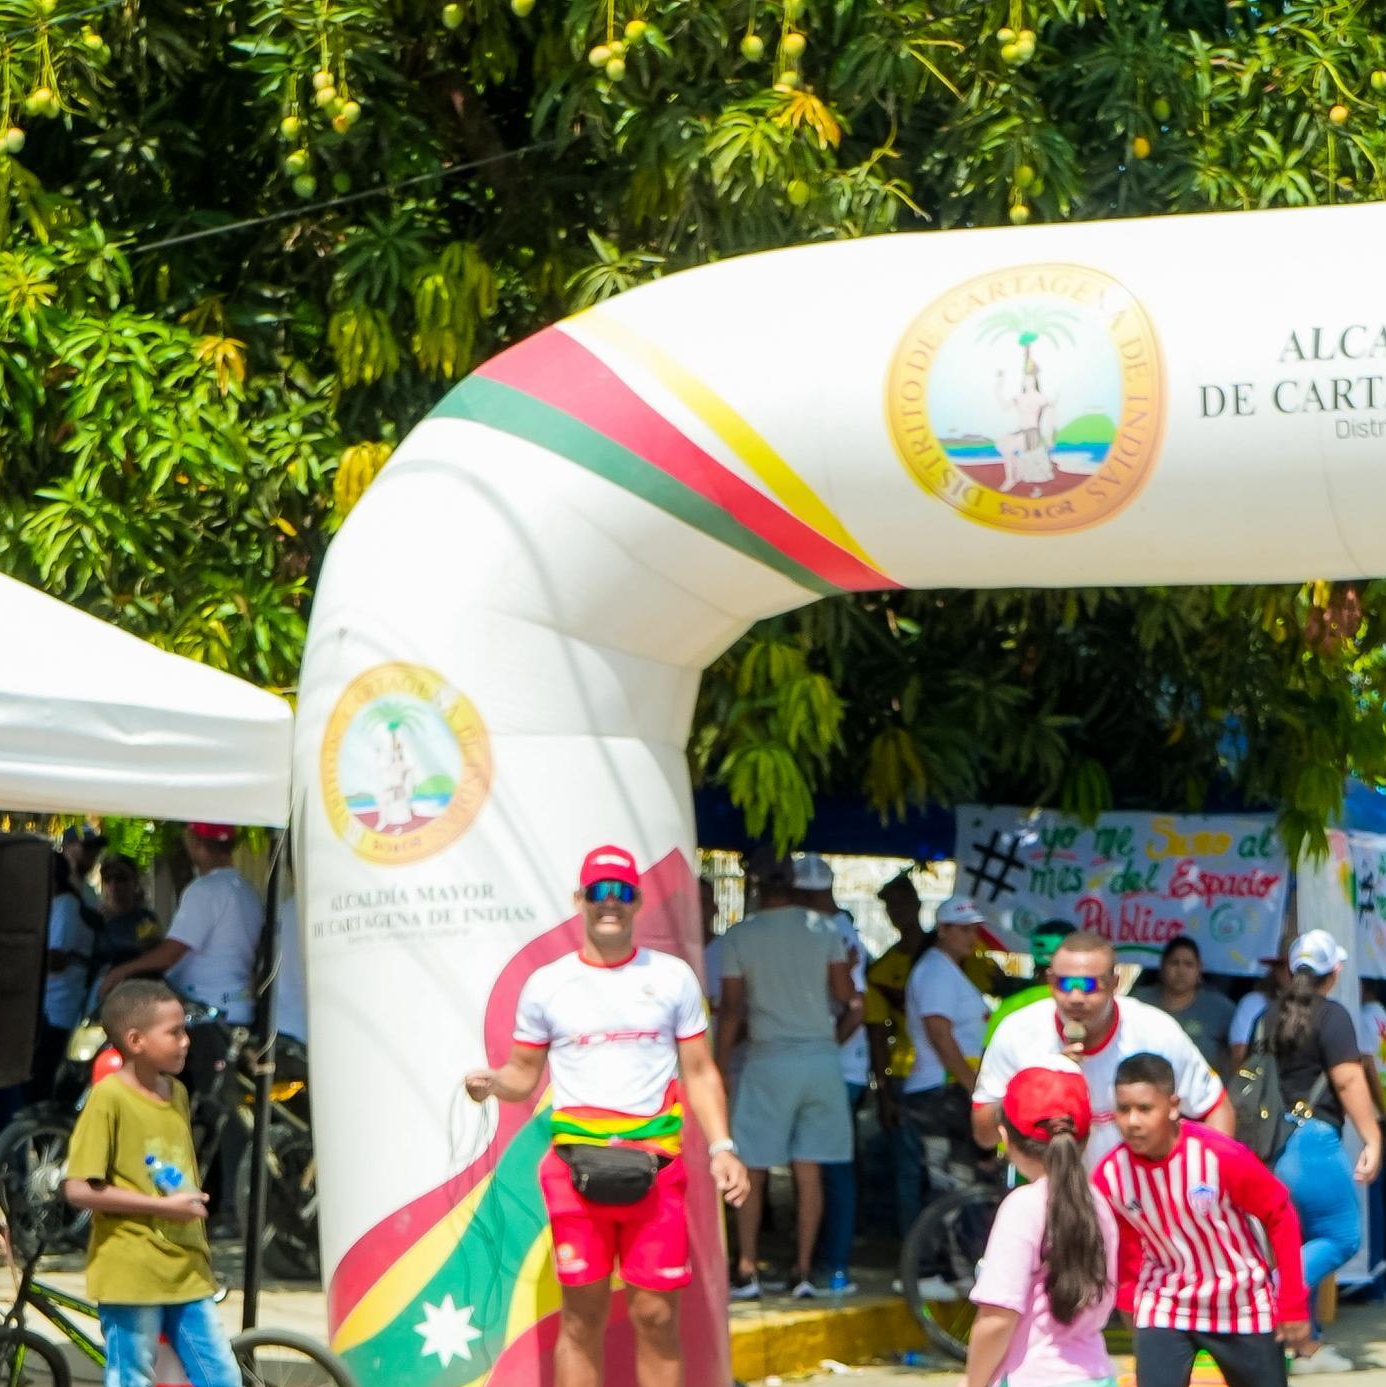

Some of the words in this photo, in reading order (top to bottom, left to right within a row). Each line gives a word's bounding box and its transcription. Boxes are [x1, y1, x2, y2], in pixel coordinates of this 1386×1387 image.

[906, 337, 936, 372] DE
[1119, 337, 1149, 383] DE
[1198, 382, 1256, 418] DE
[1084, 396, 1149, 500] INDIAS
[1237, 826, 1274, 858] al
[417, 884, 495, 901] MAYOR
[1109, 858, 1160, 894] del
[1169, 857, 1282, 909] Espacio
[463, 905, 537, 923] INDIAS
